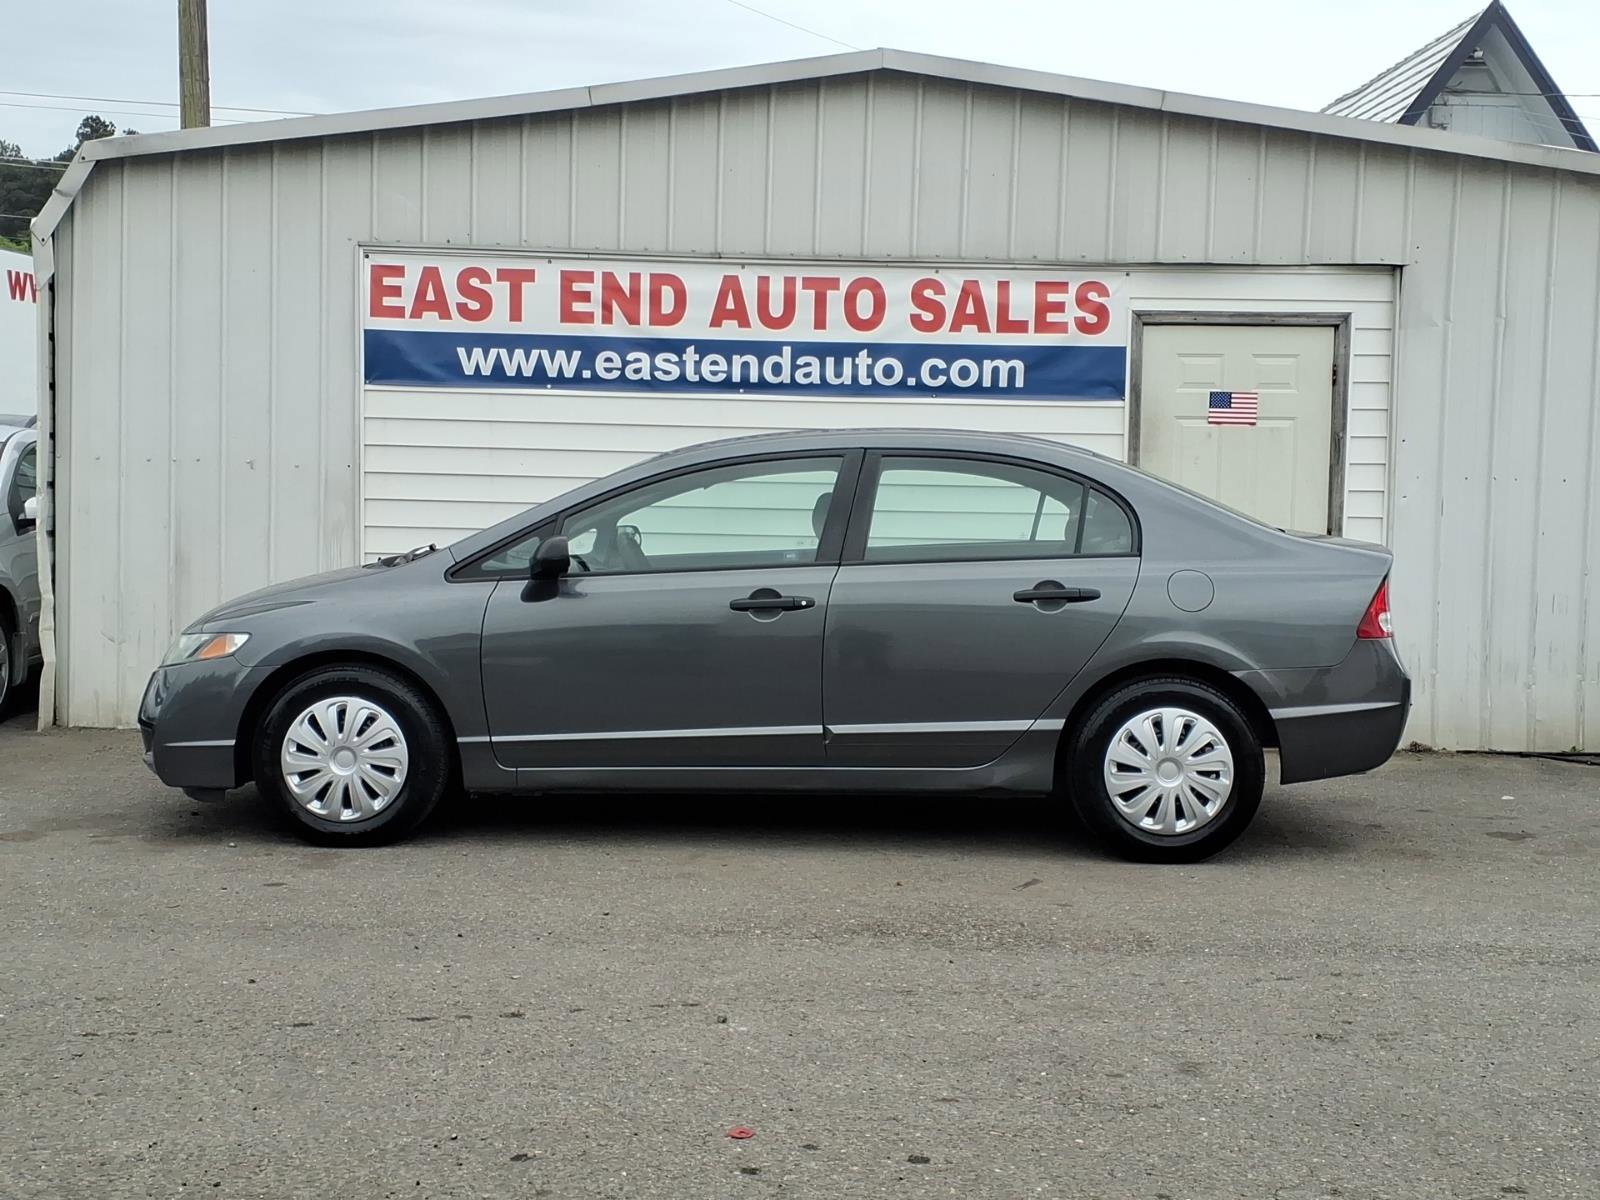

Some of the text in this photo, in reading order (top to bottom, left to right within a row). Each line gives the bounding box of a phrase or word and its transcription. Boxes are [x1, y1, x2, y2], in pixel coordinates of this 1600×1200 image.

[369, 264, 1112, 336] EAST END AUTO SALES
[456, 344, 1026, 390] www.eastendauto.com
